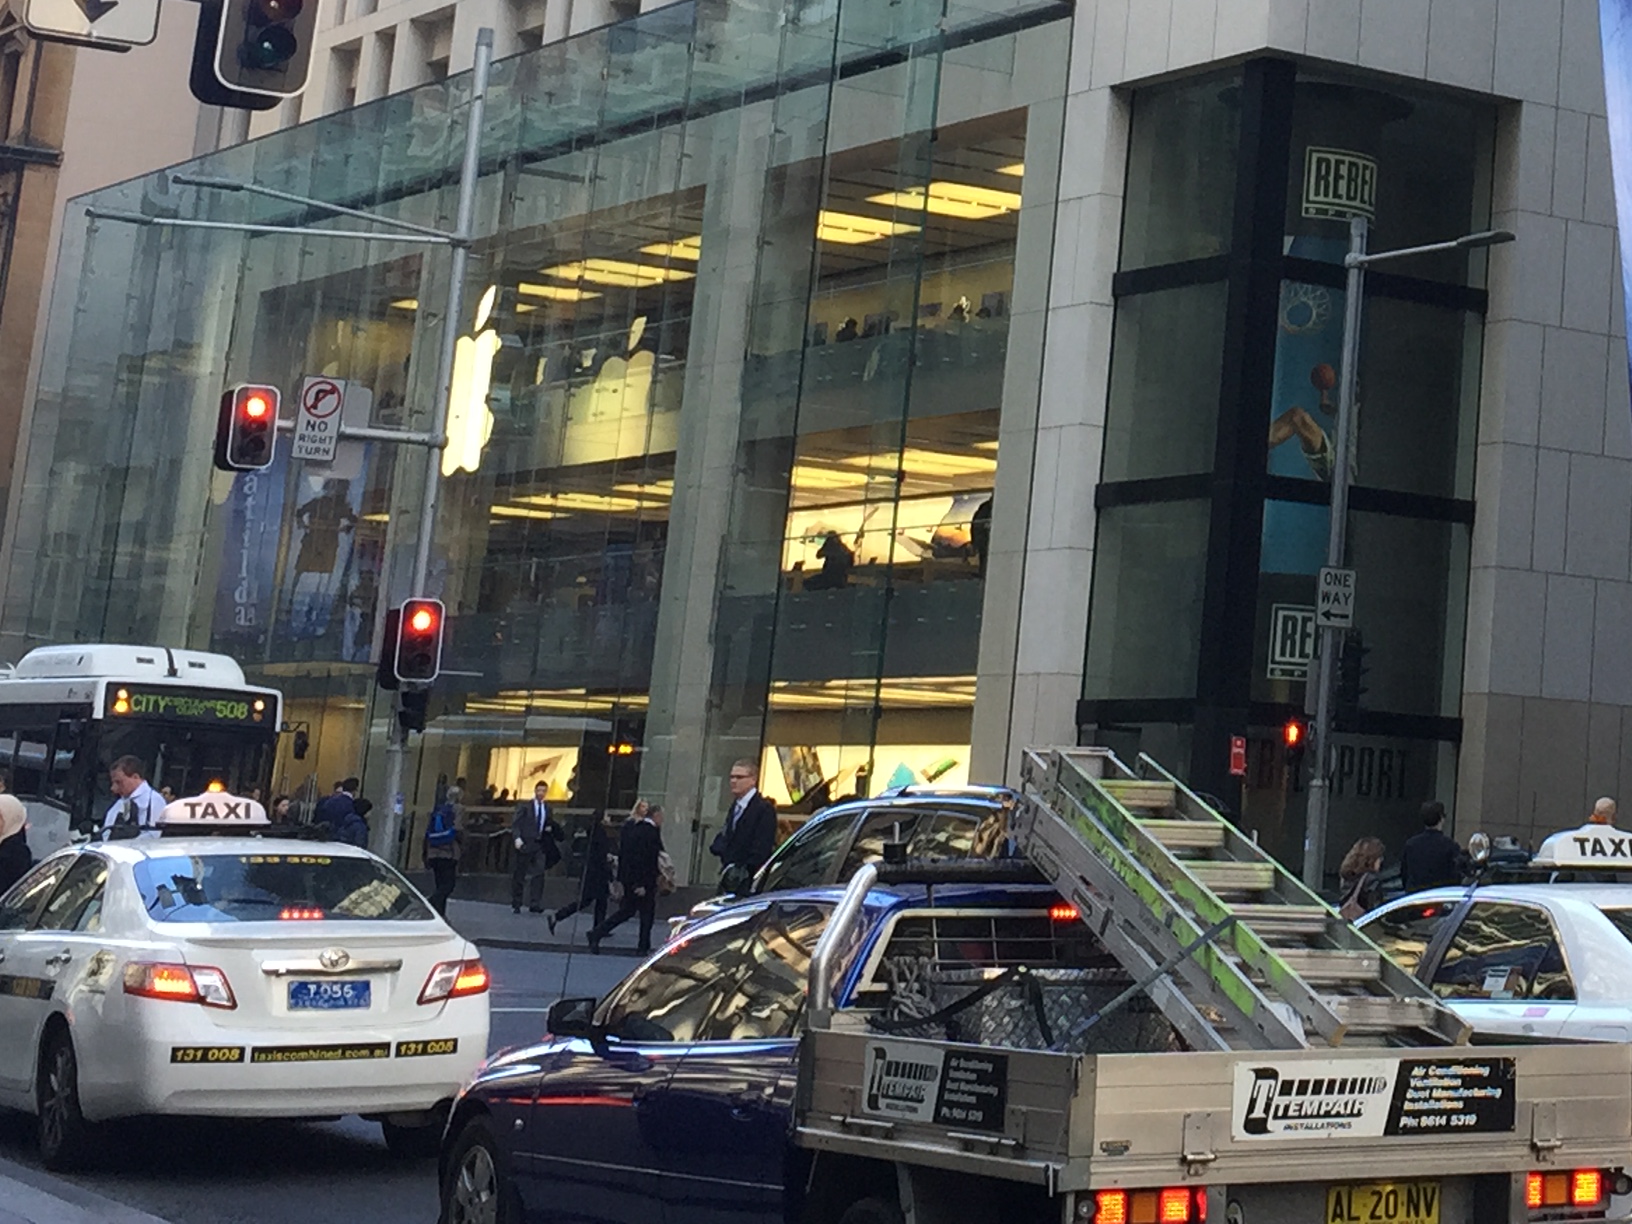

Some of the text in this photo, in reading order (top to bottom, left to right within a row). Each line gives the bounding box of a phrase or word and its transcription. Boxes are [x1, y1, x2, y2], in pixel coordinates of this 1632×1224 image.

[1314, 156, 1375, 206] REBEL
[305, 419, 328, 433] NO
[298, 433, 333, 445] RIGHT
[297, 444, 330, 456] TURN
[1323, 572, 1351, 588] ONE
[1321, 590, 1352, 606] WAY
[130, 694, 249, 719] CITY 508
[184, 803, 251, 820] TAXI
[175, 1048, 241, 1061] 131 008
[399, 1042, 423, 1055] 131
